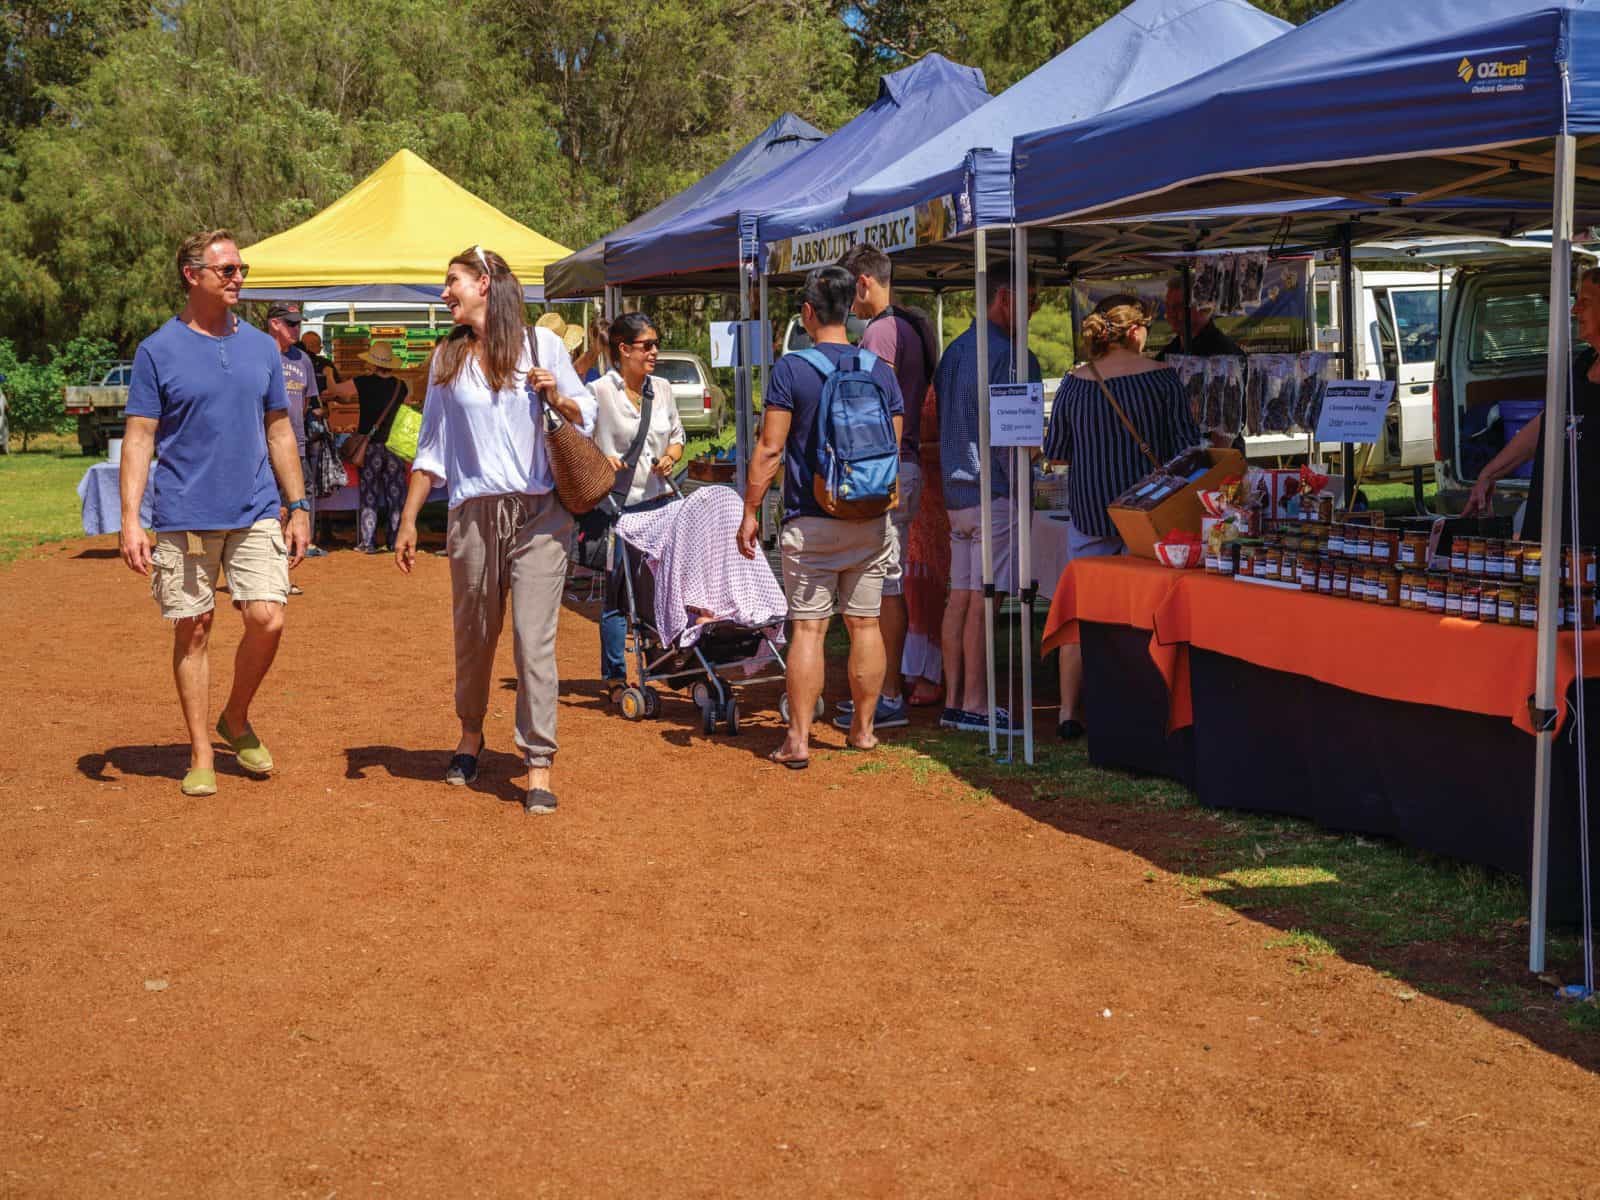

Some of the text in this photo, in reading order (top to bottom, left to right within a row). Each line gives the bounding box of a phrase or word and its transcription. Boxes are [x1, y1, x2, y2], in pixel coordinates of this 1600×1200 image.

[1477, 59, 1527, 78] OZtrail
[796, 216, 910, 265] ABSOLUTE JERKY
